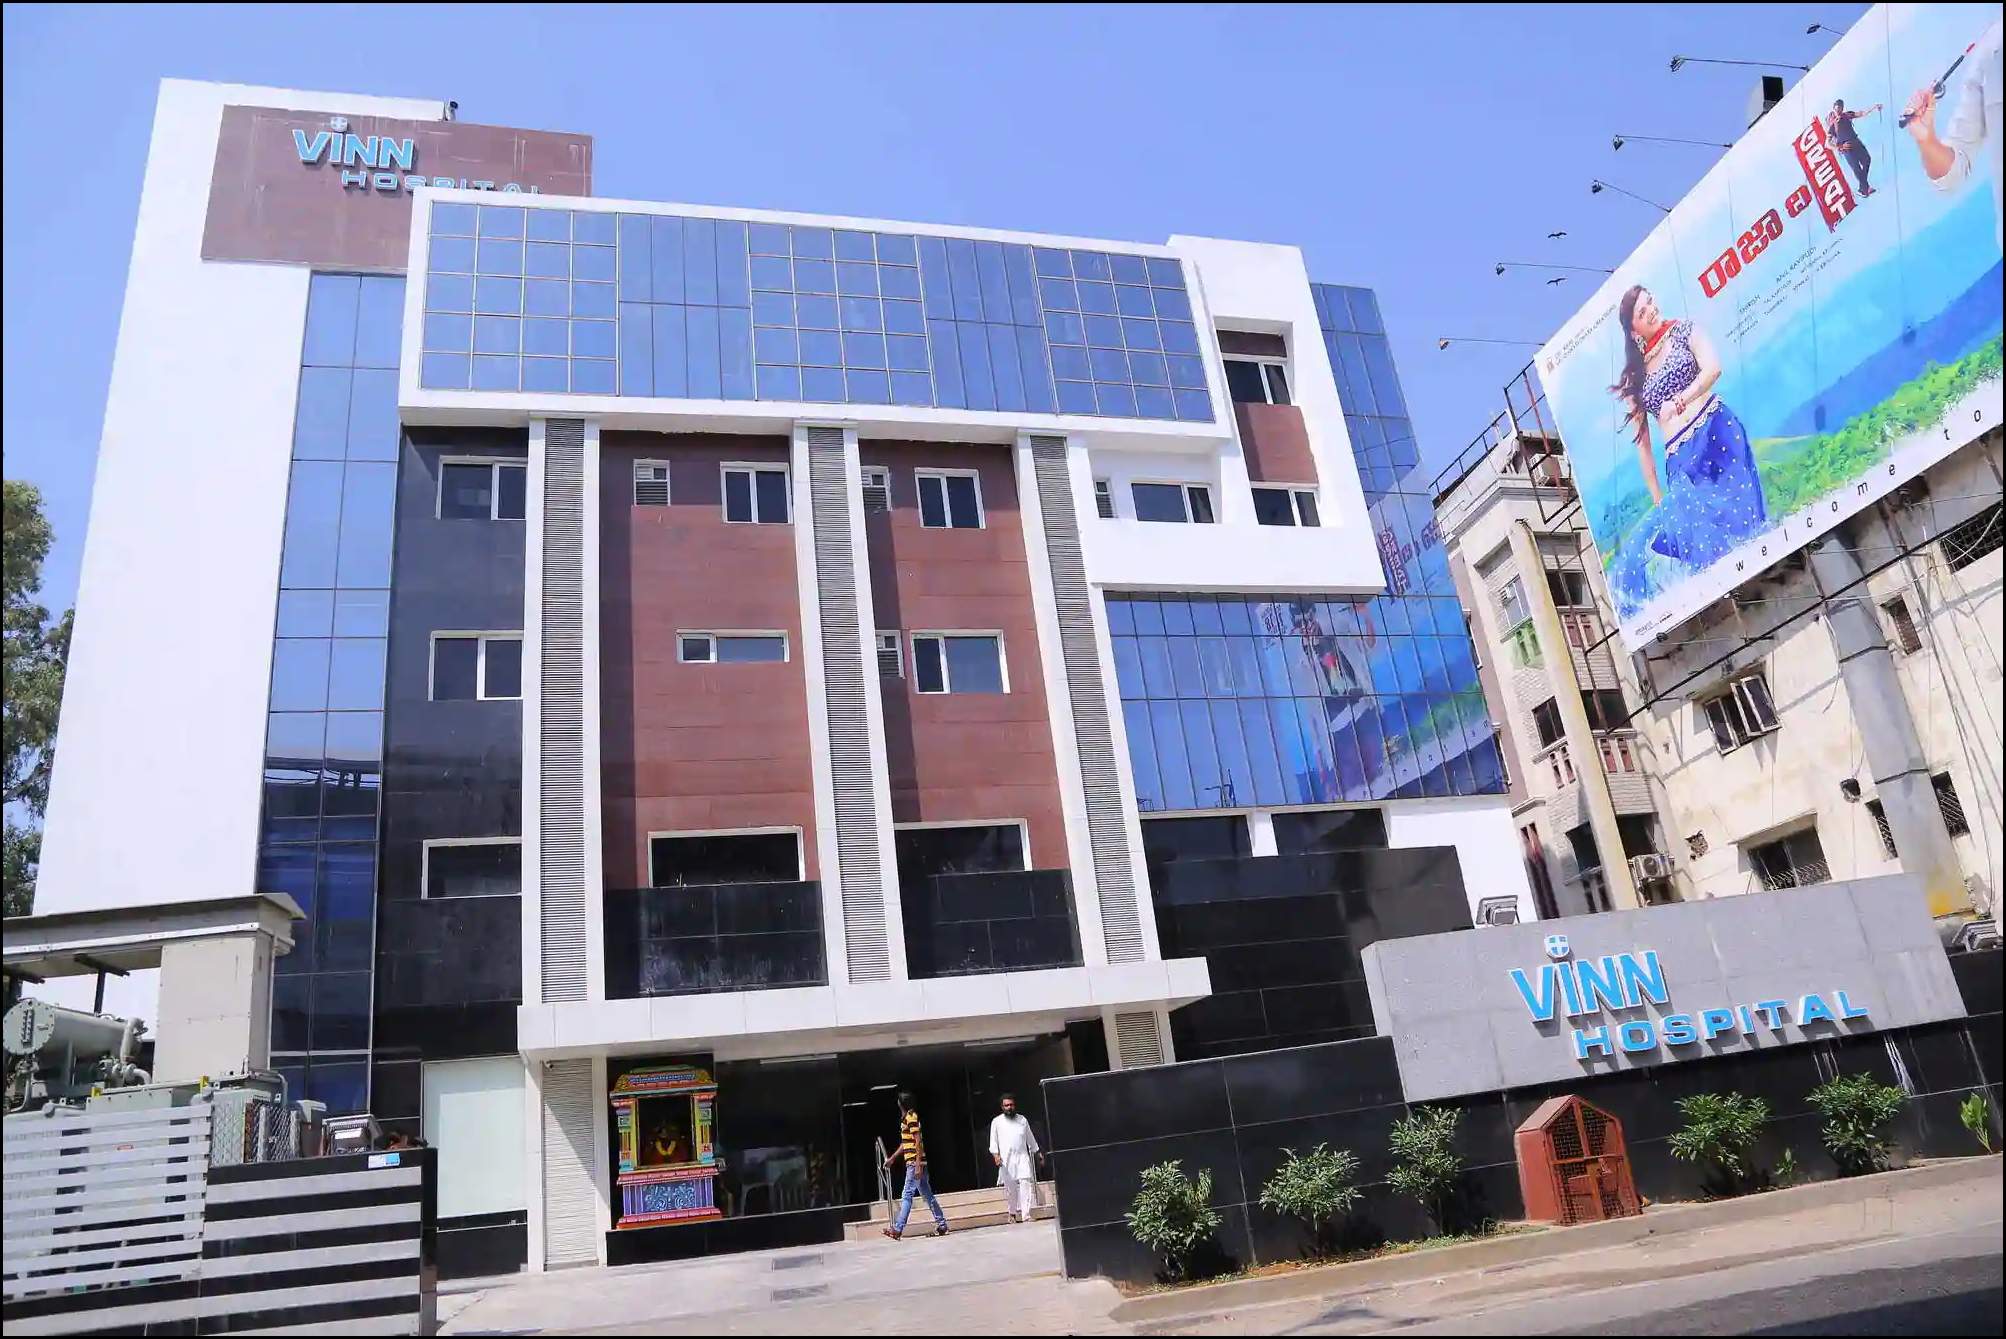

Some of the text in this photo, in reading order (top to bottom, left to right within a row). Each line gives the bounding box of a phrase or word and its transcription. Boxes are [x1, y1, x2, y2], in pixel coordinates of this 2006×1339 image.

[292, 129, 413, 169] VINN
[1799, 124, 1849, 219] GREAT
[1698, 208, 1784, 298] రాజా
[1735, 409, 1982, 573] welcome to
[1508, 949, 1670, 1023] VINN
[1571, 990, 1869, 1061] HOSPITAL
